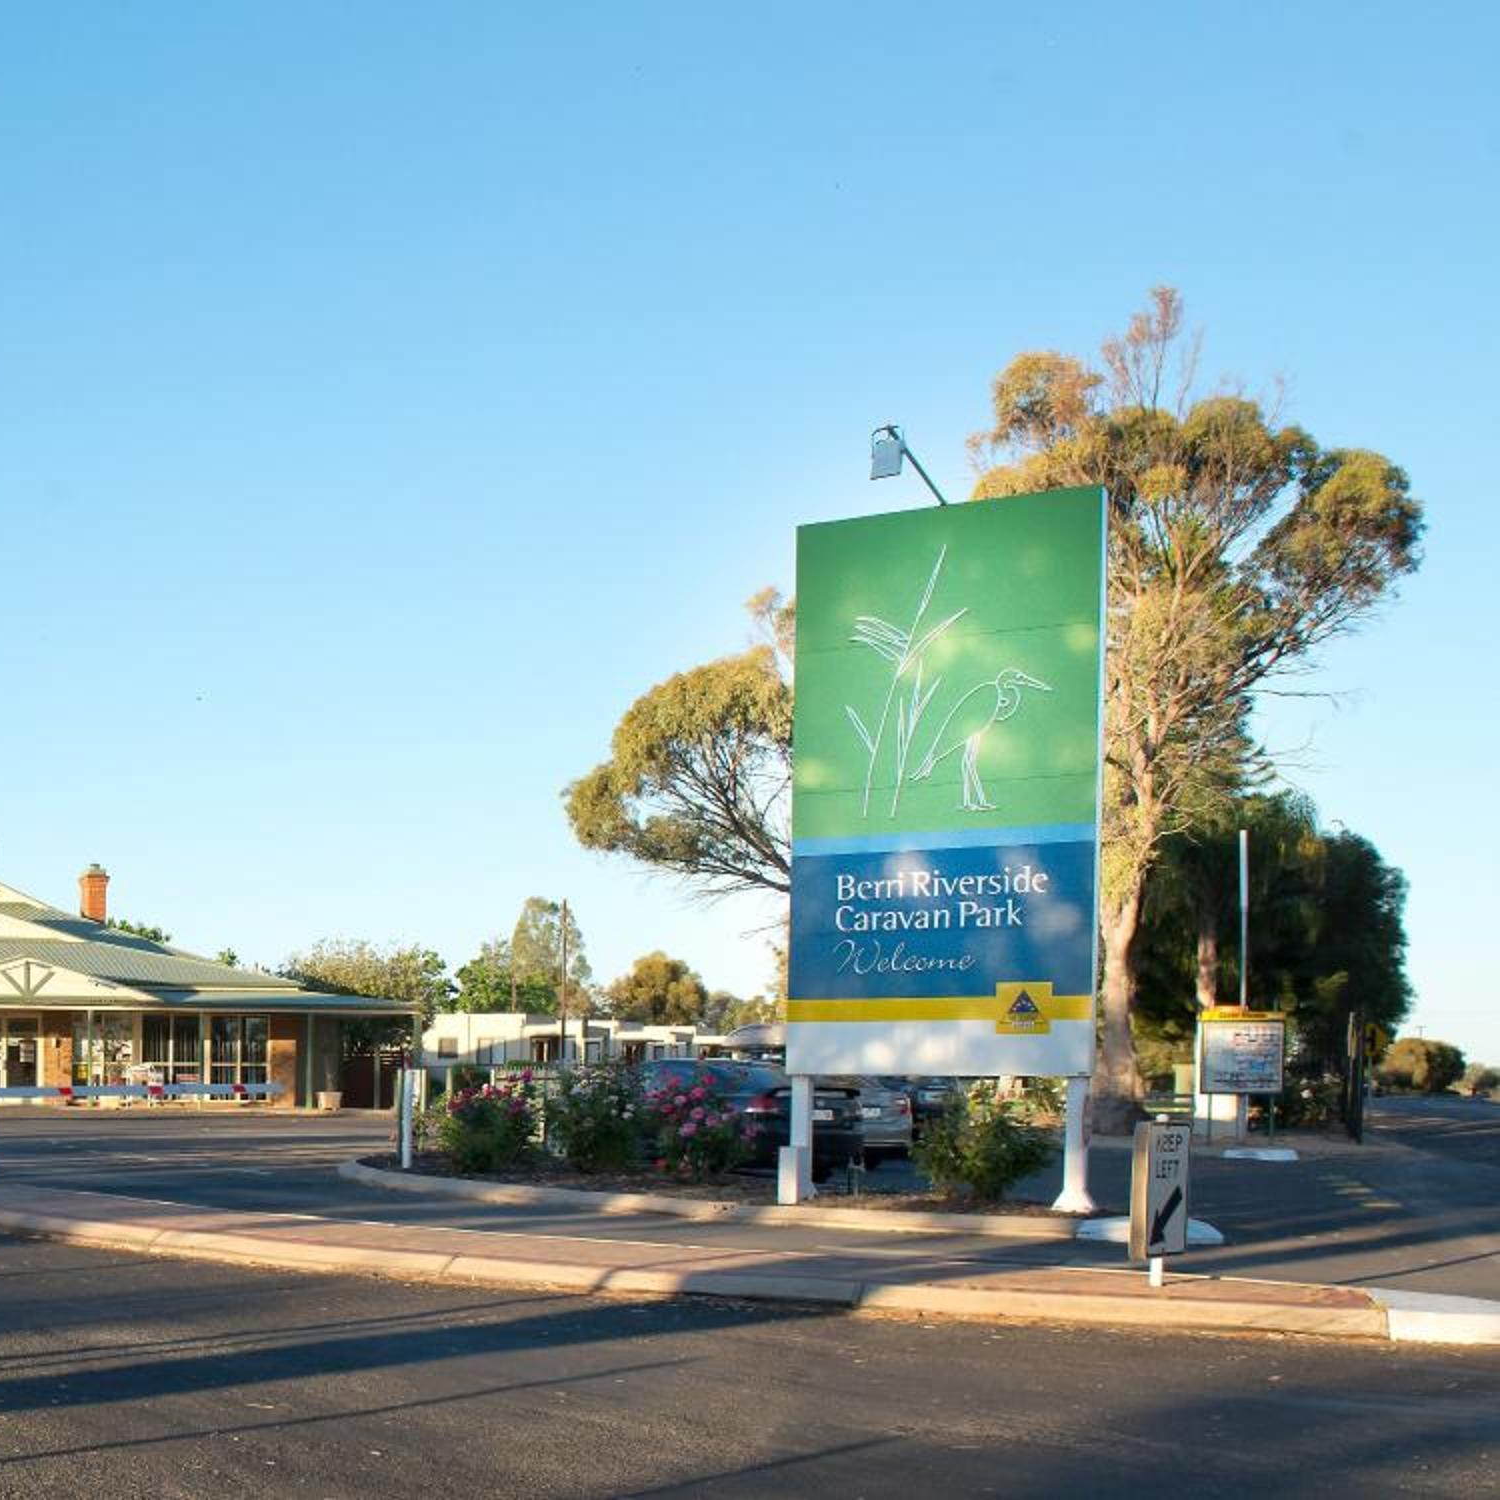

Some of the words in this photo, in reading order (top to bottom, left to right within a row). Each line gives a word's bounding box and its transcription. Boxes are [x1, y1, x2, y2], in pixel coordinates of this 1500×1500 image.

[836, 872, 903, 901] Berri
[912, 866, 1049, 898] Riverside
[835, 904, 950, 932] Caravan
[958, 899, 1023, 929] Park
[834, 938, 976, 975] Welcome
[1155, 1134, 1184, 1152] KEEP
[1155, 1159, 1180, 1179] LEFT
